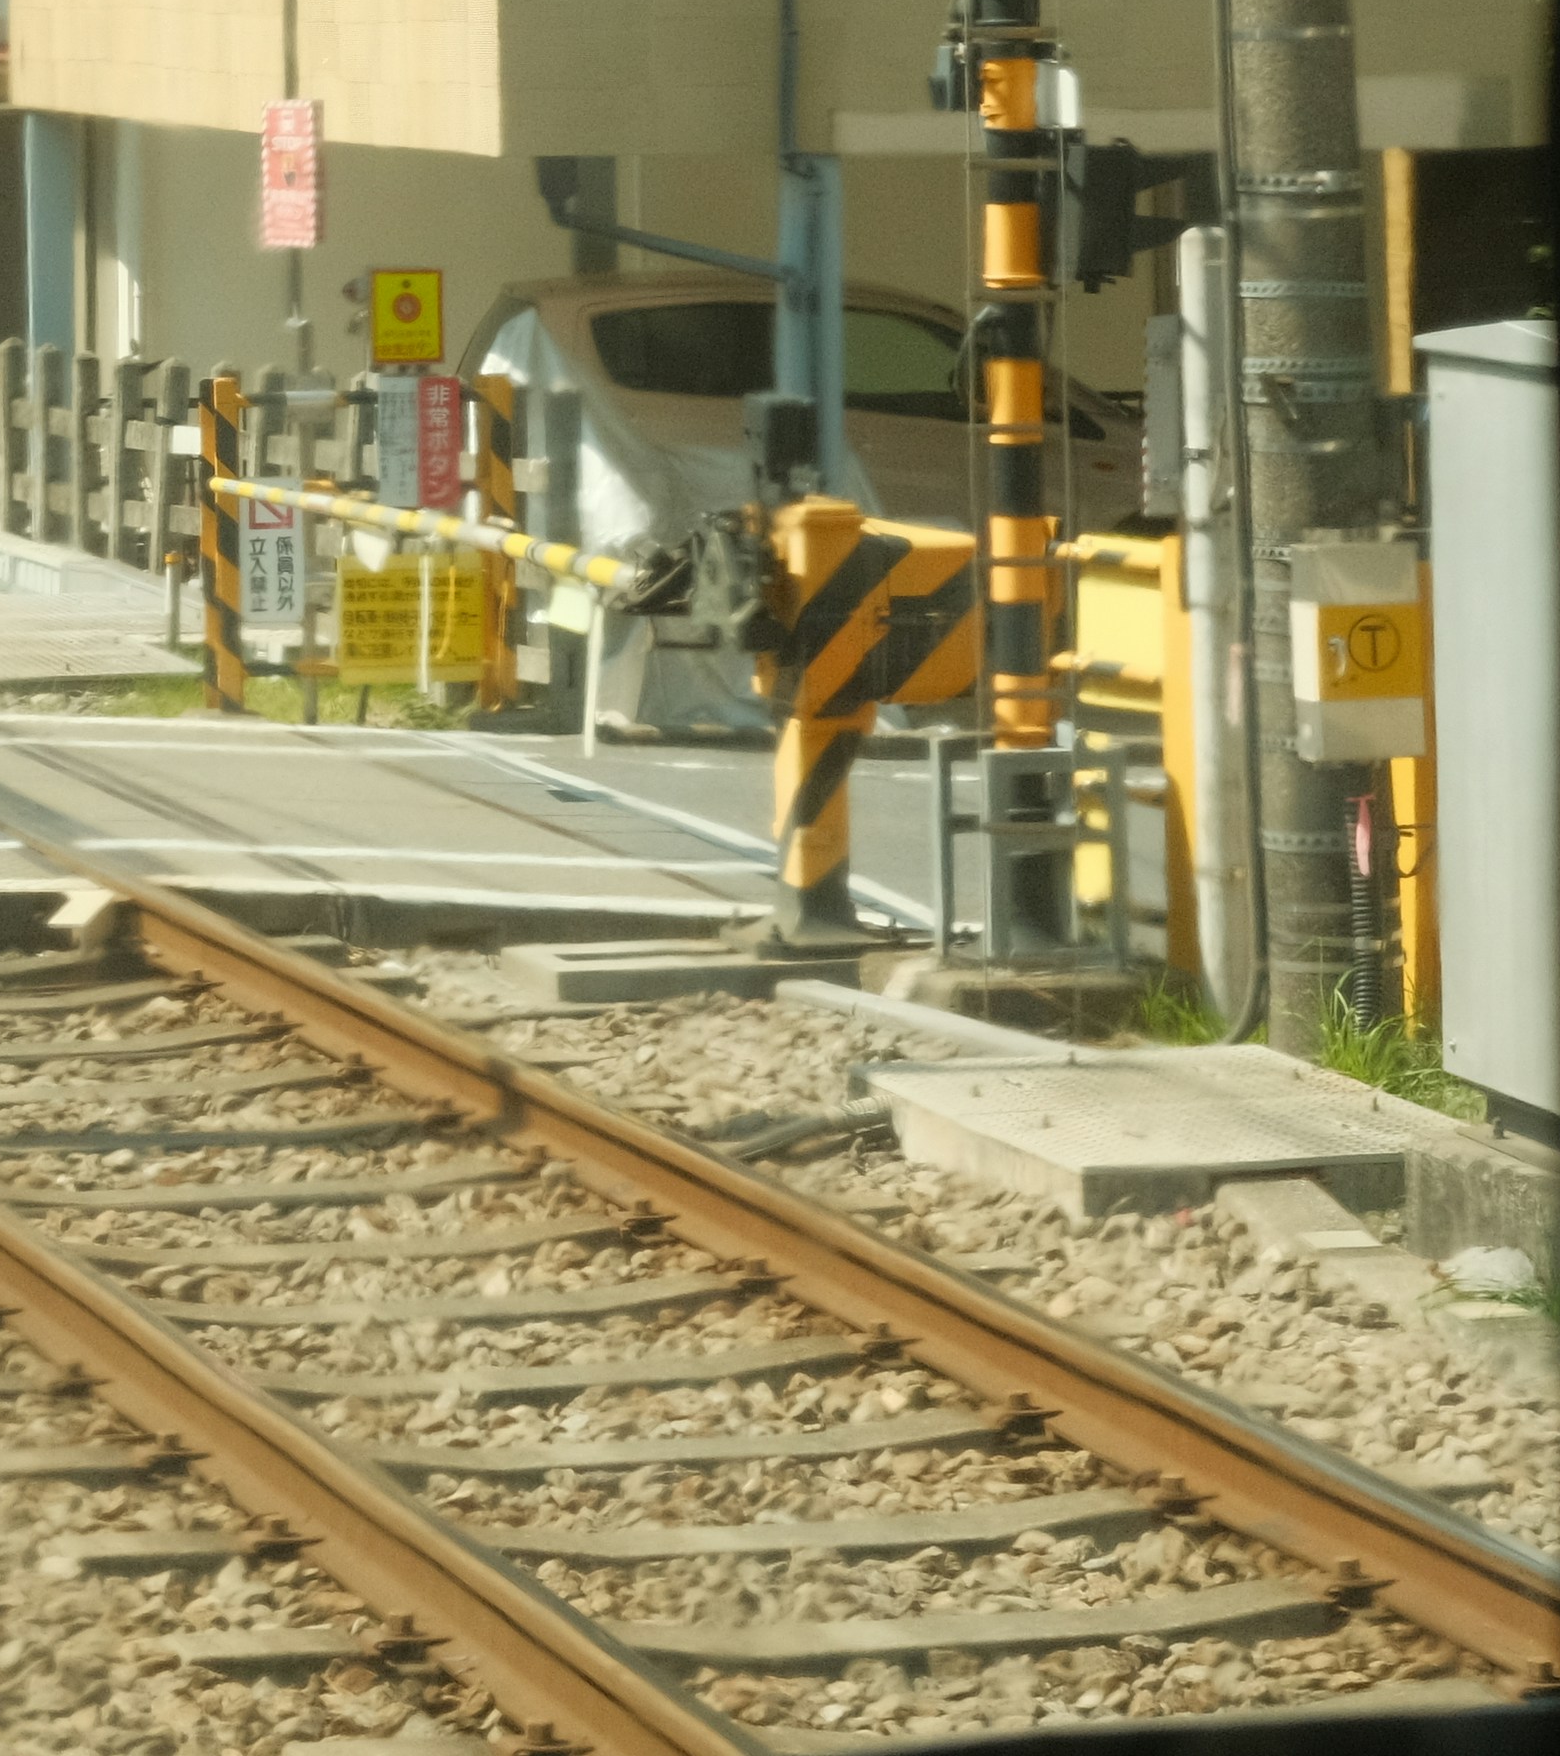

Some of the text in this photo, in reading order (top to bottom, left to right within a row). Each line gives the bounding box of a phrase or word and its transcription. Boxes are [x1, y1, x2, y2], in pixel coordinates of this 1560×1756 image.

[426, 384, 451, 500] 非常ボタン
[249, 536, 268, 613] 立入禁止
[276, 536, 295, 612] 係員以外
